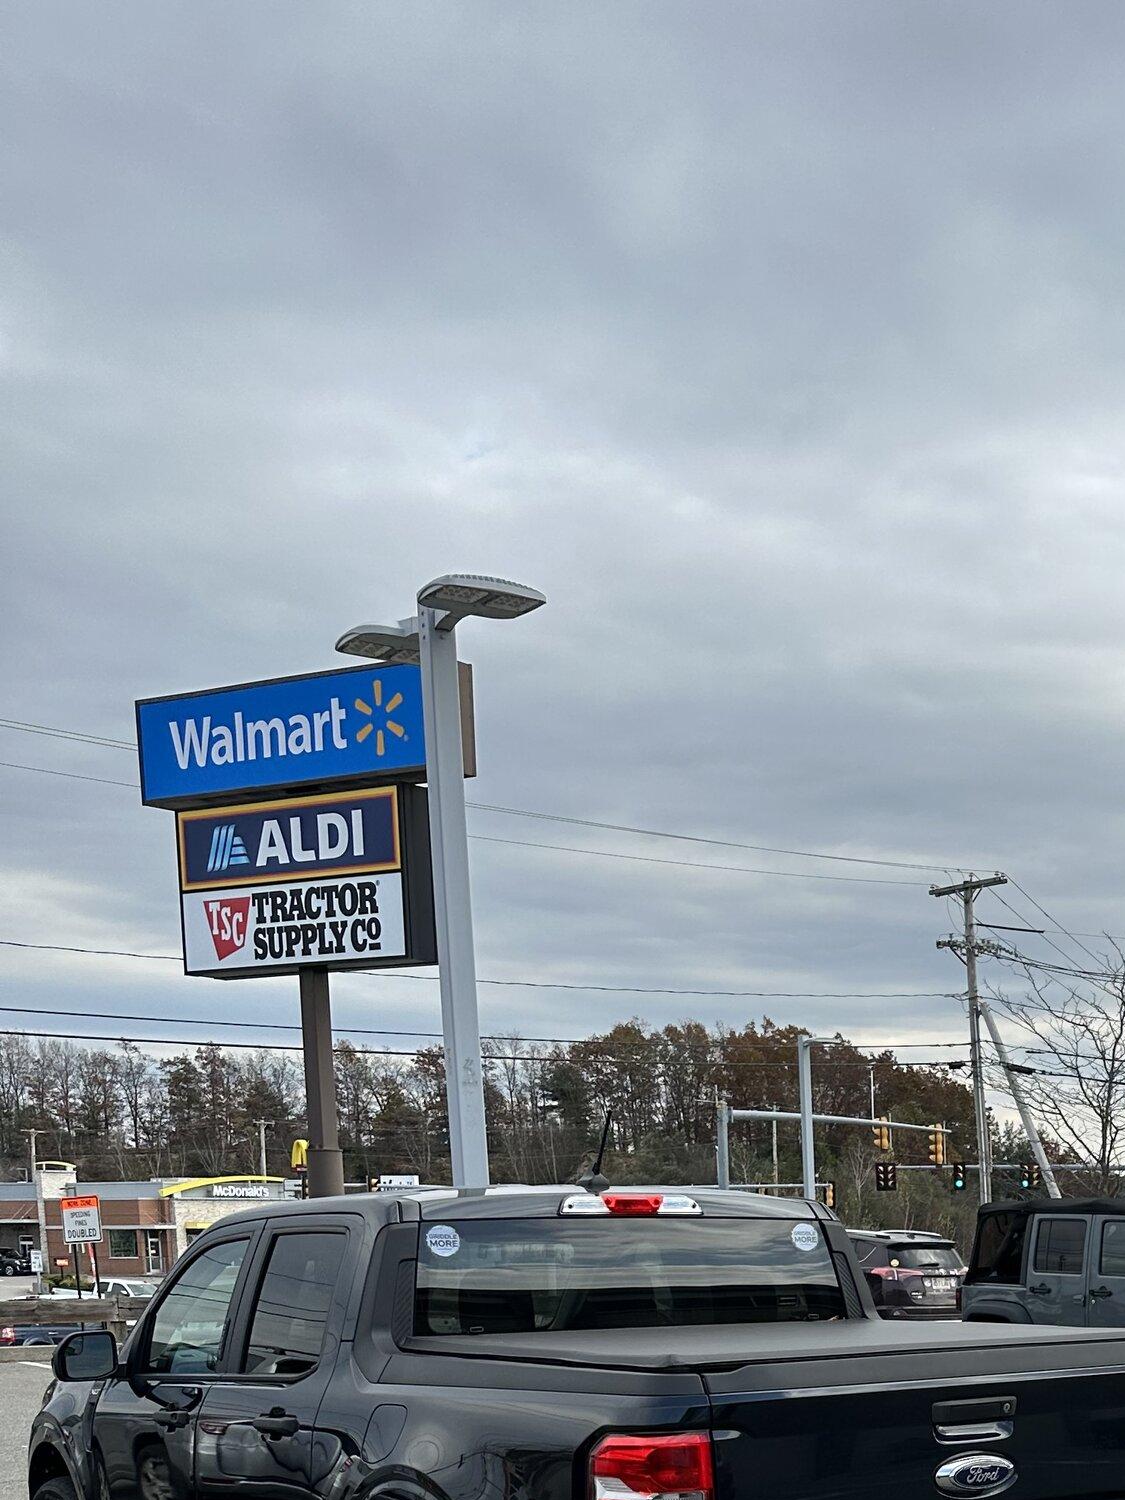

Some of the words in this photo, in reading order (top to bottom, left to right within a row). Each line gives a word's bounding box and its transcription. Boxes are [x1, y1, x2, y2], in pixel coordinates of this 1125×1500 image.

[169, 697, 348, 770] Walmart
[255, 809, 365, 867] ALDI
[251, 881, 379, 924] TRACTOR
[209, 901, 244, 947] TSC
[253, 920, 348, 960] SUPPLY
[212, 1185, 270, 1198] McDonald's
[67, 1228, 97, 1239] DOUBLED
[430, 1239, 459, 1248] MORE
[966, 1464, 1001, 1485] Ford
